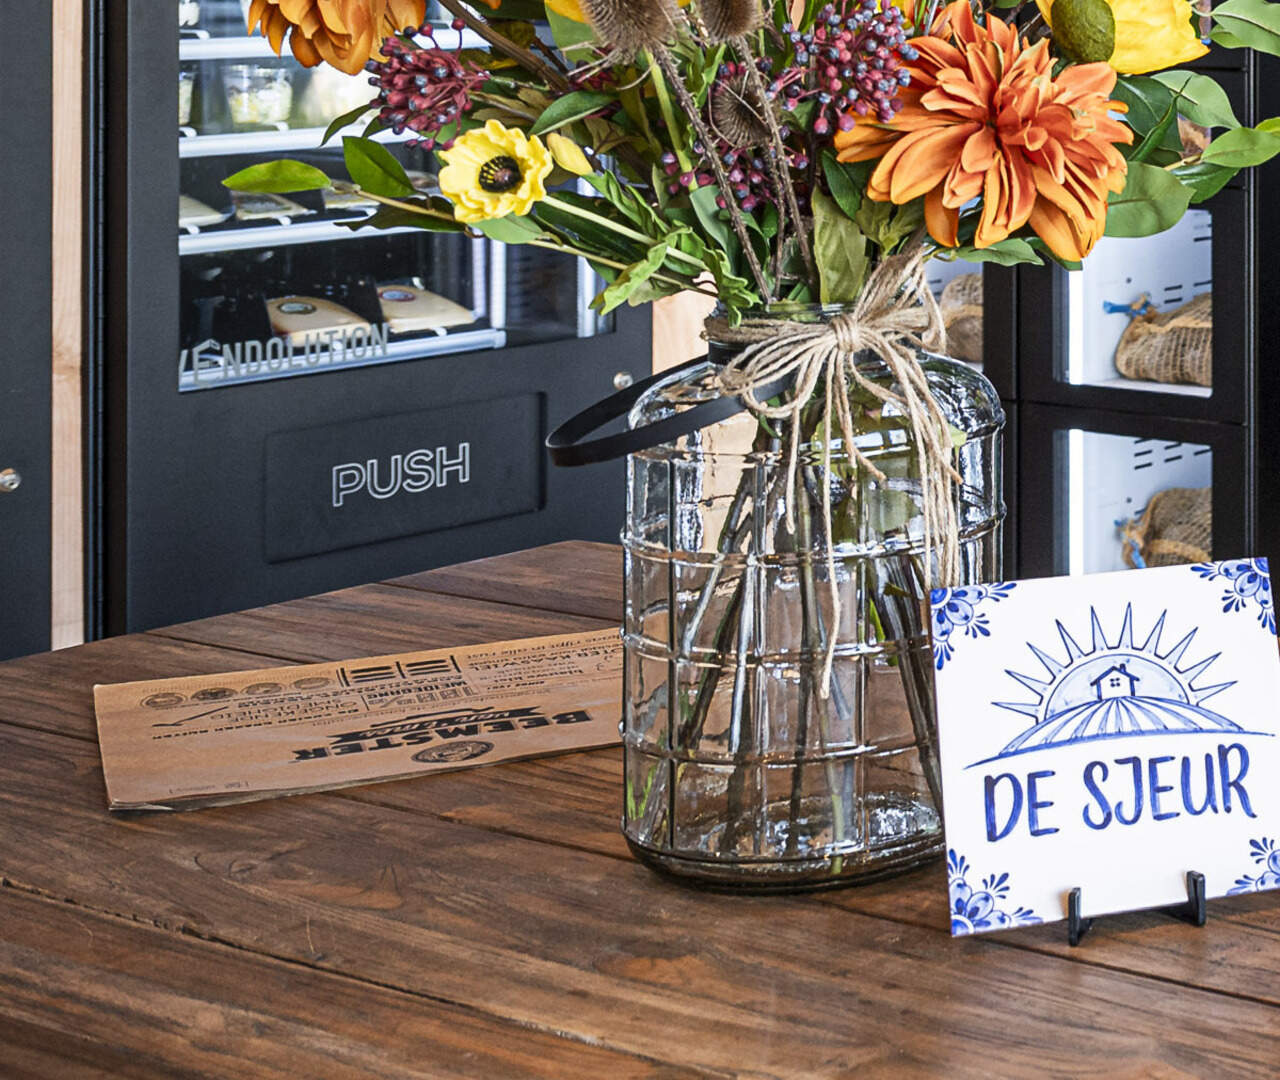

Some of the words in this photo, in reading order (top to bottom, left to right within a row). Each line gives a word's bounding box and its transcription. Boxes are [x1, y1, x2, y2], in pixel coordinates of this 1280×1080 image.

[331, 442, 471, 507] PUSH
[469, 654, 571, 671] KAASWIEL
[365, 680, 467, 699] WEIDEGANG
[291, 710, 591, 760] BEEMSTER
[984, 770, 1060, 843] DE
[1082, 743, 1258, 831] SJEUR
